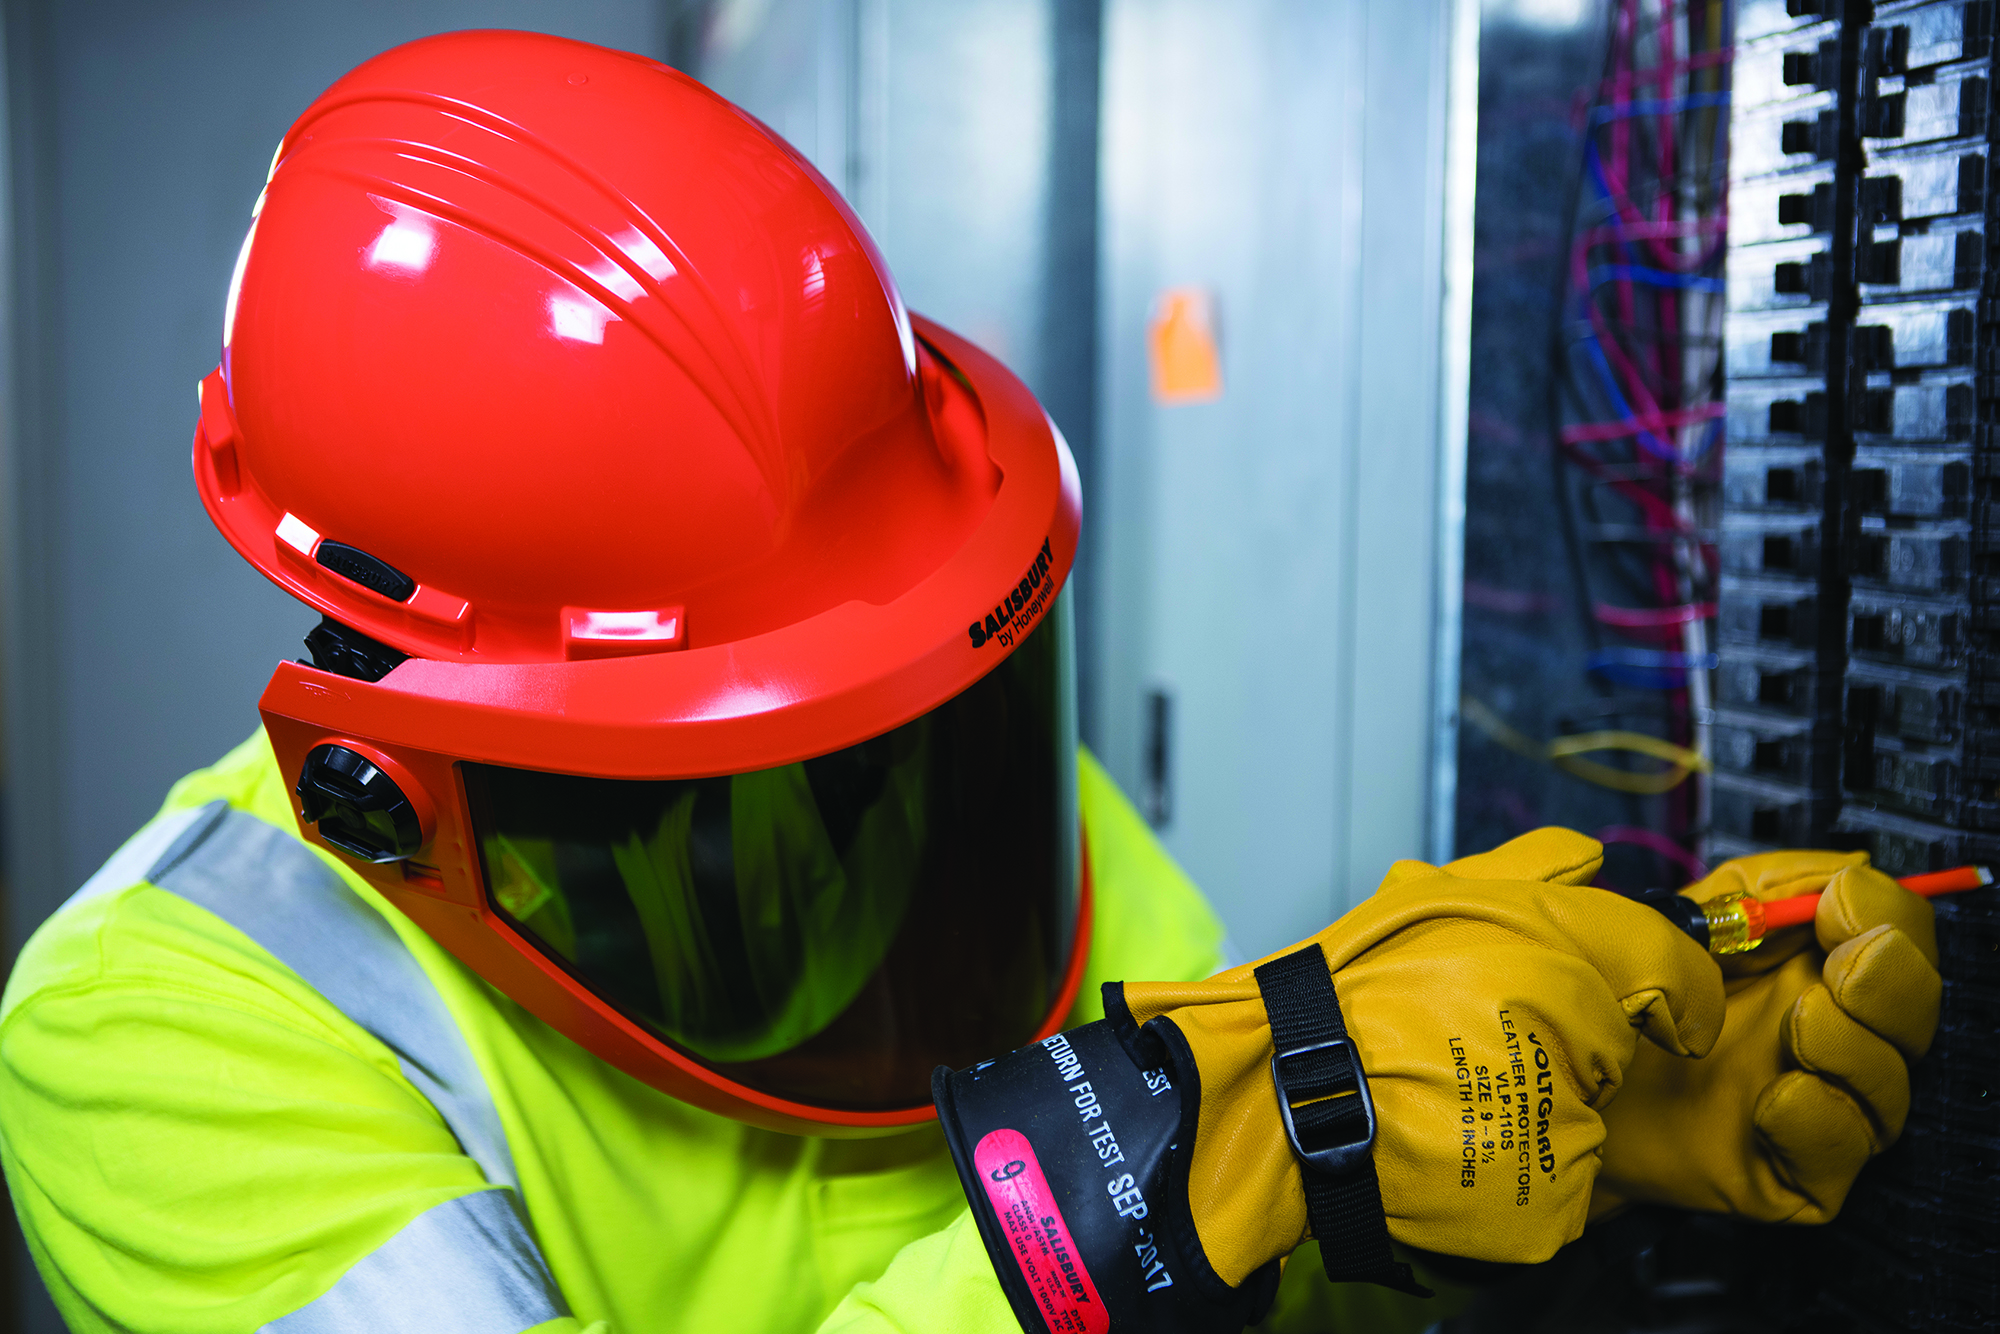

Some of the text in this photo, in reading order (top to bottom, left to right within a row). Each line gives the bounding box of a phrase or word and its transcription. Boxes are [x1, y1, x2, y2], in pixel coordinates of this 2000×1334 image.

[968, 536, 1054, 649] SALISBURY
[996, 573, 1055, 648] by Honeywell
[1449, 1037, 1477, 1189] LENGTH 10 INCHES
[1474, 1065, 1493, 1103] SIZE
[1480, 1112, 1494, 1121] 9
[1495, 1071, 1515, 1151] VLP-110S
[1499, 1009, 1531, 1207] LEATHER PROTECTORS
[991, 1159, 1026, 1182] 9
[1069, 1080, 1103, 1122] FOR
[1089, 1120, 1125, 1168] TEST
[1107, 1172, 1149, 1220] SEP
[1012, 1203, 1029, 1233] CLASS
[1003, 1211, 1064, 1332] MAX USE VOLT 1000V AC
[1040, 1216, 1091, 1304] SALISBURY
[1050, 1270, 1062, 1289] MADE
[1060, 1309, 1075, 1332] TYPE
[1070, 1308, 1087, 1333] D120
